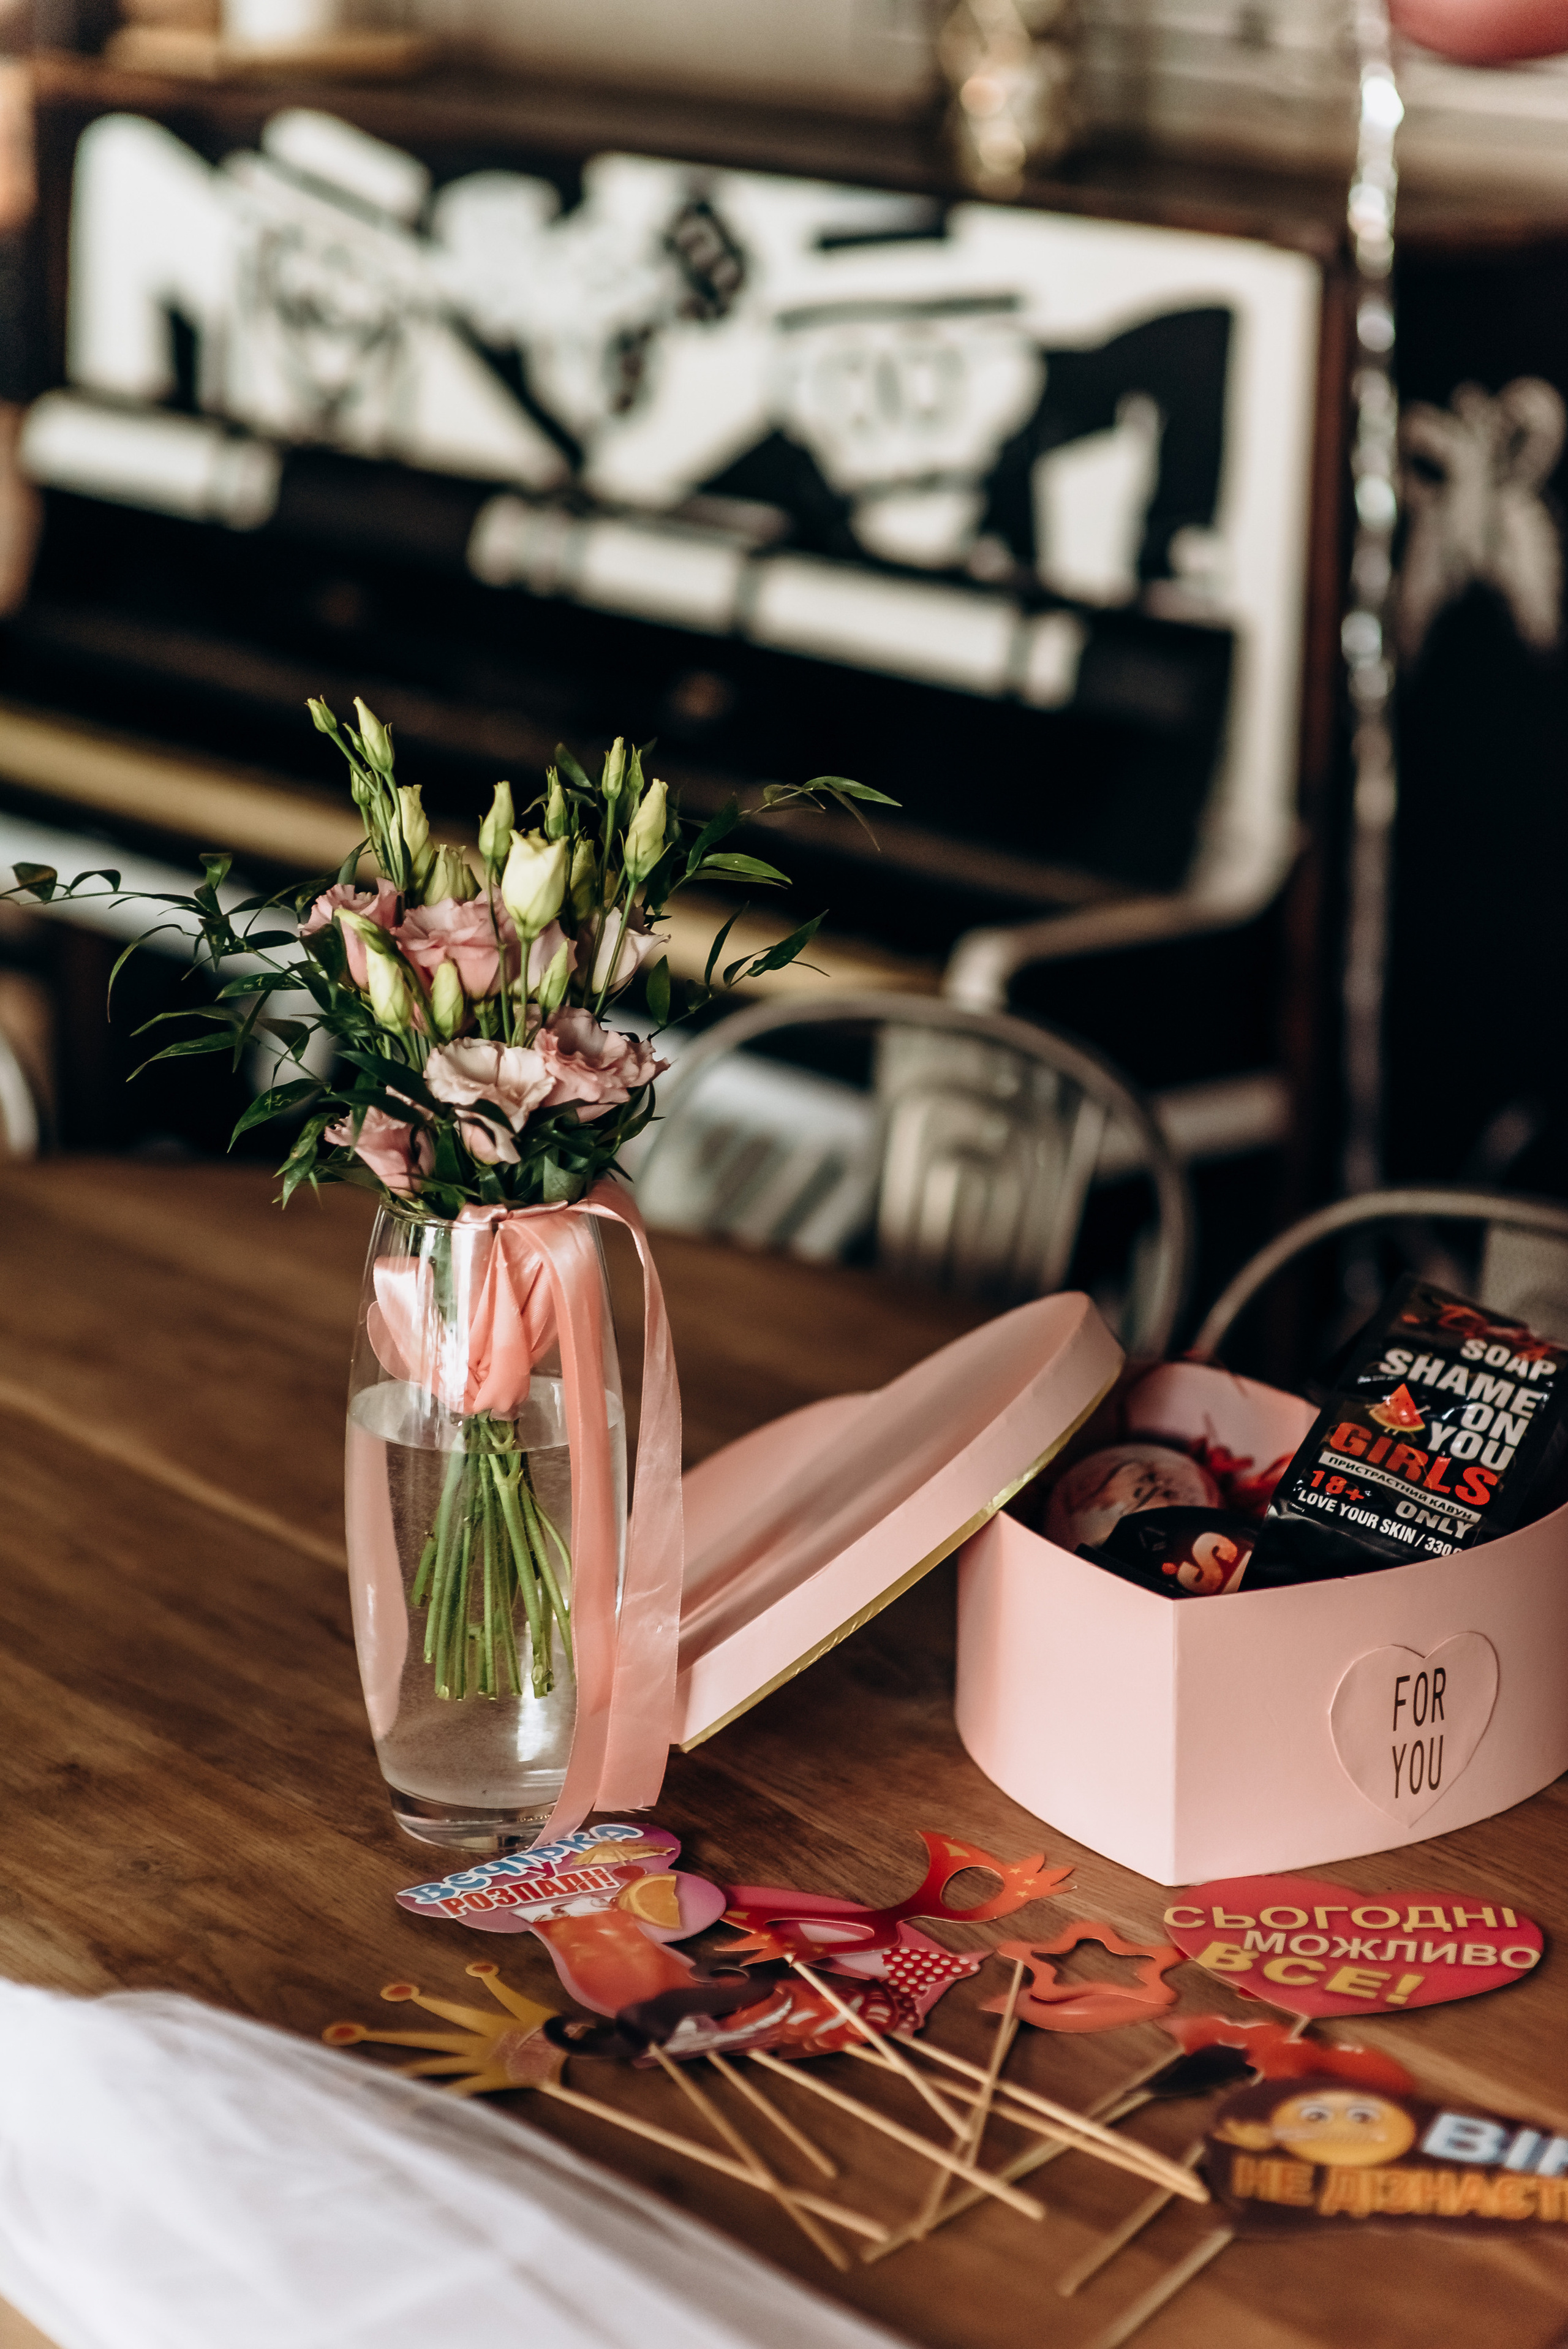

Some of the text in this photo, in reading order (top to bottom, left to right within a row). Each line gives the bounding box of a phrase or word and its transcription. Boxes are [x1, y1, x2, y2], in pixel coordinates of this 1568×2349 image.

[1379, 1348, 1545, 1419] SHAME
[1460, 1339, 1557, 1380] SOAP
[1427, 1421, 1516, 1471] YOU
[1461, 1402, 1530, 1447] ON
[1310, 1470, 1365, 1501] 18+
[1328, 1456, 1473, 1521] ПРИСТРАСТНИЙ КАВУН
[1330, 1422, 1498, 1506] GIRLS
[1297, 1489, 1338, 1513] LOVE
[1339, 1503, 1380, 1530] YOUR
[1379, 1519, 1418, 1545] SKIN
[1395, 1500, 1474, 1540] ONLY
[1393, 1666, 1447, 1732] FOR
[1392, 1734, 1444, 1799] YOU
[440, 1868, 616, 1916] РОЗПАДІ!
[1164, 1906, 1519, 1932] СЬОГОДНІ
[1195, 1941, 1425, 2005] ВСЕ!
[1243, 1931, 1541, 1969] МОЖЛИВО
[1232, 2154, 1315, 2206] НЕ
